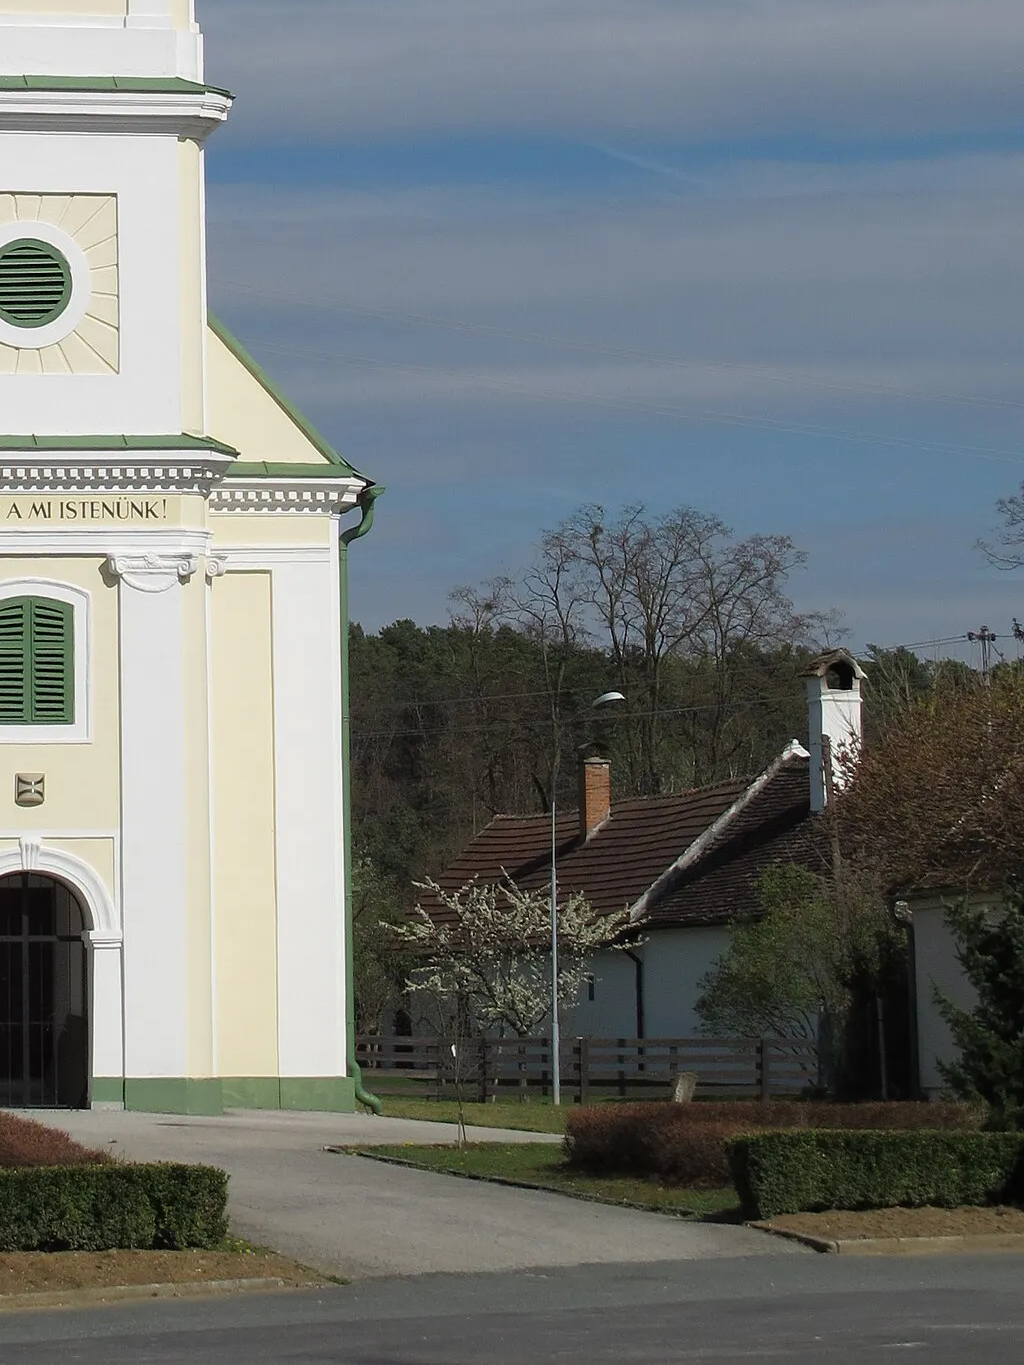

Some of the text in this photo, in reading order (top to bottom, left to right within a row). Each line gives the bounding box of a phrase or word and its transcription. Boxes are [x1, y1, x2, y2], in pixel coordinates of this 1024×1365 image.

[6, 500, 23, 520] A
[28, 501, 52, 520] MI
[59, 496, 167, 520] ISTENÜNK!
